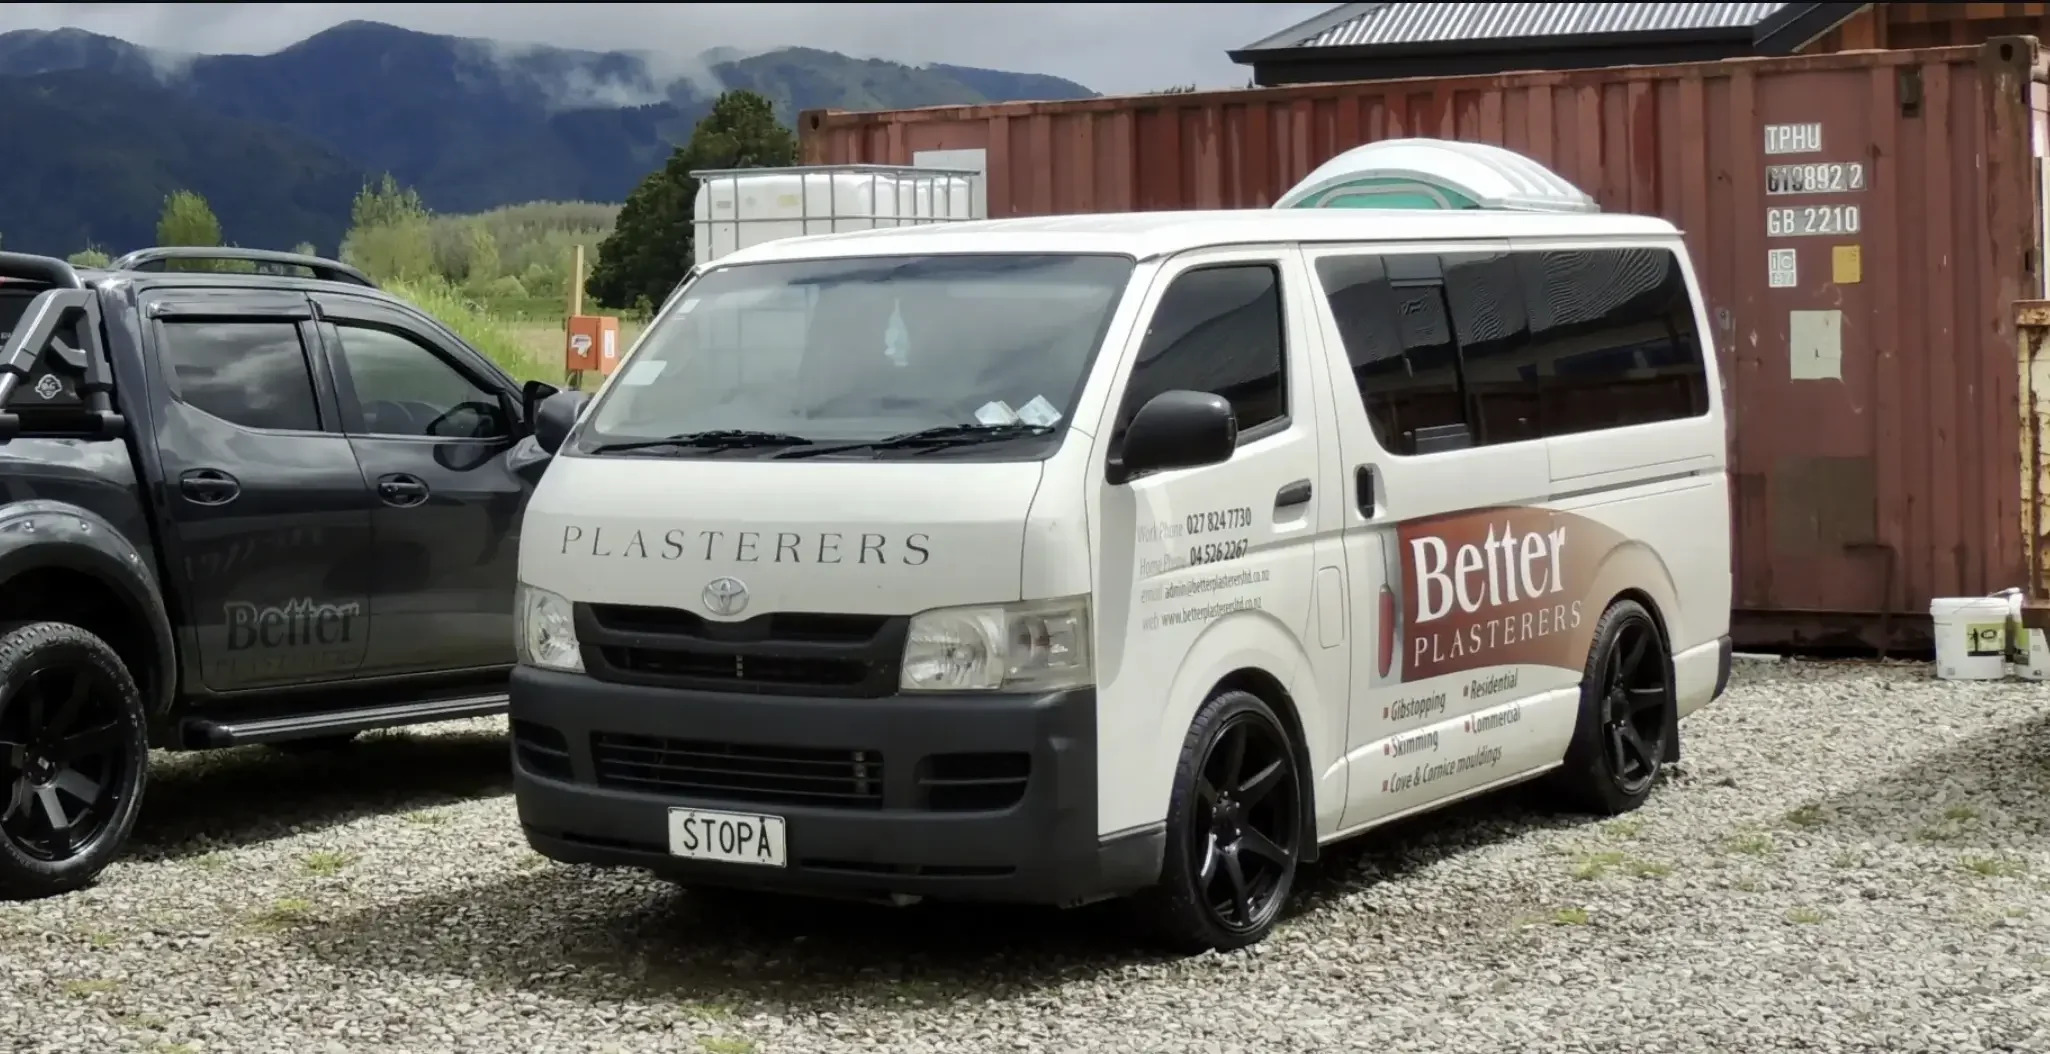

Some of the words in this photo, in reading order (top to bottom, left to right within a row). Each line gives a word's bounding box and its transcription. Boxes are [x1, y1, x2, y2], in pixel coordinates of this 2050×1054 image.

[1766, 124, 1820, 151] TPHU
[1849, 164, 1863, 188] 2
[1768, 209, 1795, 234] GB
[1804, 206, 1858, 233] 2210
[1137, 520, 1157, 543] Work
[1159, 520, 1183, 540] Phone
[1186, 513, 1205, 535] 027
[1207, 510, 1227, 533] 824
[1227, 507, 1251, 530] 7730
[561, 525, 930, 566] PLASTERERS
[1189, 545, 1203, 567] 04
[1204, 541, 1223, 565] 526
[1223, 538, 1248, 561] 2267
[1410, 519, 1566, 624] Better
[223, 596, 360, 652] Better
[1142, 611, 1160, 631] web
[1414, 600, 1582, 668] PLASTERERS
[1470, 667, 1519, 700] Residential
[1390, 689, 1447, 722] Gibstopping
[1470, 704, 1521, 734] Commercial
[1391, 729, 1439, 758] Skimming
[1389, 771, 1412, 793] Cove
[1413, 766, 1422, 787] &
[1423, 758, 1456, 783] Cornice
[1456, 745, 1503, 773] mouldings
[683, 817, 772, 858] STOPA
